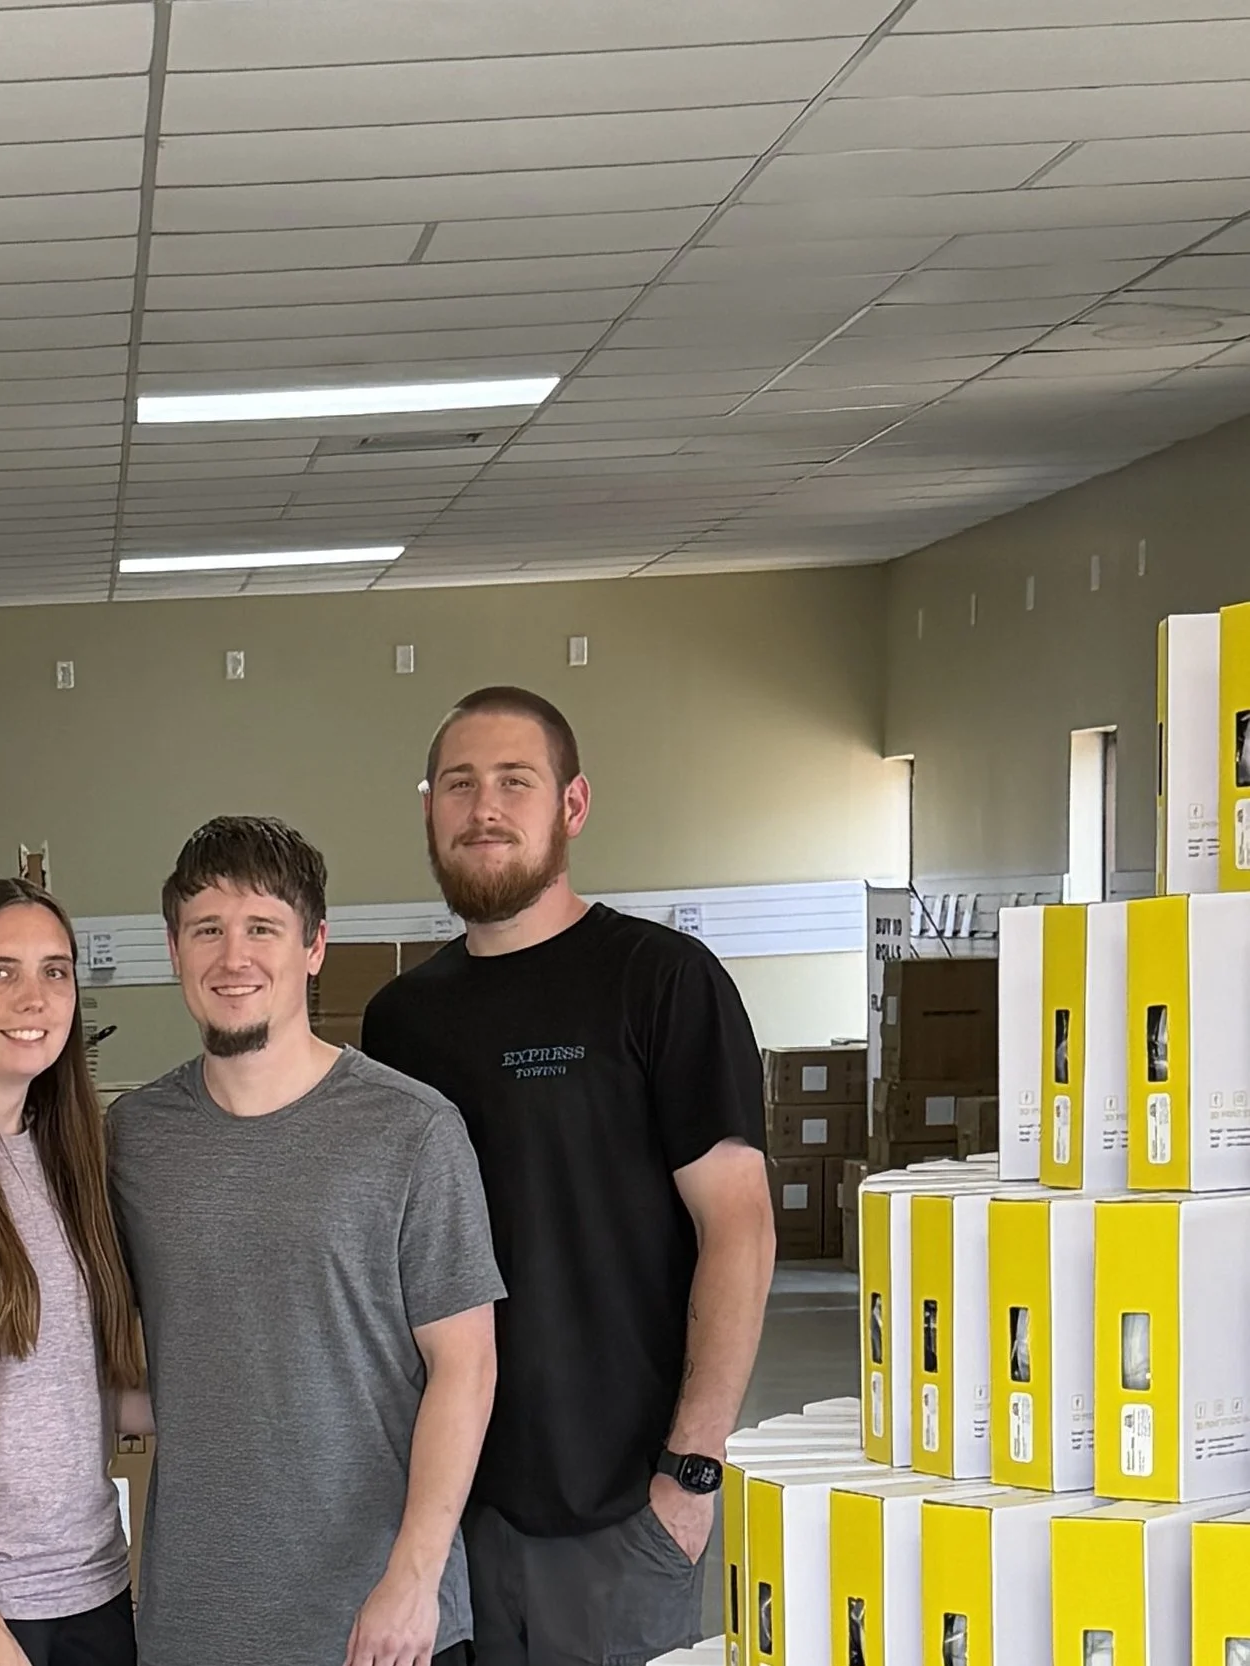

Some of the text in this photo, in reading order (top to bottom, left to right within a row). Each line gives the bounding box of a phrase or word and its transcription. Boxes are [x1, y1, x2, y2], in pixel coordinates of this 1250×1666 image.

[875, 917, 892, 937] BUY
[875, 942, 902, 961] ROLLS
[501, 1045, 586, 1067] EXPRESS
[515, 1065, 567, 1080] TOWING
